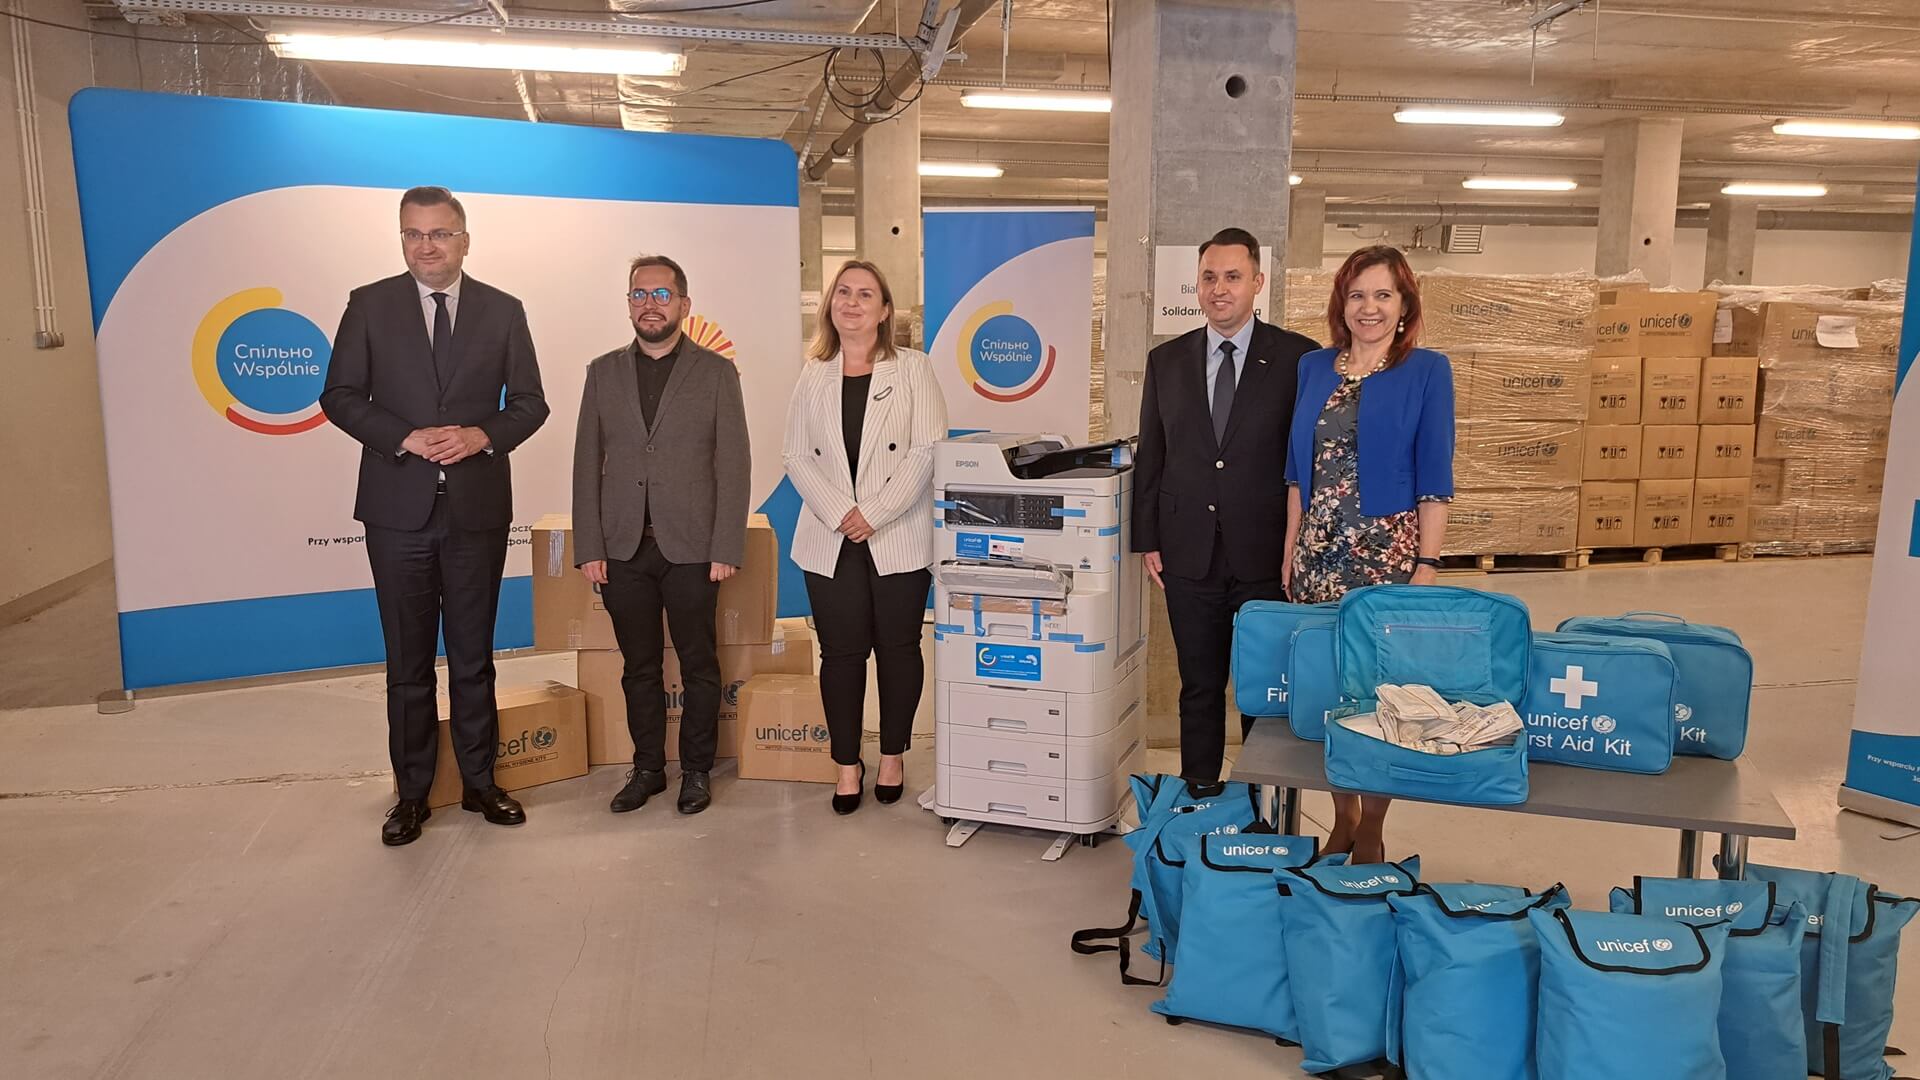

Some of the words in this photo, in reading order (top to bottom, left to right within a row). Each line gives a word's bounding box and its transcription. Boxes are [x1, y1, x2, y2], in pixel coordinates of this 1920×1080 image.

[1639, 314, 1677, 328] unicef
[1596, 322, 1616, 336] icef
[1791, 326, 1818, 340] unic
[234, 343, 313, 359] Спільно
[981, 338, 1029, 350] Спільно
[980, 351, 1033, 364] Wspólnie
[233, 360, 320, 379] Wspólnie
[1502, 373, 1545, 389] unicef
[1498, 441, 1541, 457] unicef
[955, 460, 979, 468] EPSON
[308, 537, 329, 547] Przy
[332, 535, 366, 545] wspar
[1267, 687, 1289, 702] Fir
[1527, 712, 1589, 731] unicef
[755, 723, 808, 741] unicef
[1680, 726, 1707, 744] Kit
[497, 730, 529, 758] cef
[1528, 734, 1553, 748] rst
[1561, 735, 1595, 752] Aid
[1604, 738, 1632, 756] Kit
[1223, 843, 1270, 856] unicef
[1339, 875, 1383, 889] unicef
[1665, 904, 1723, 918] unicef
[1596, 938, 1651, 953] unicef
